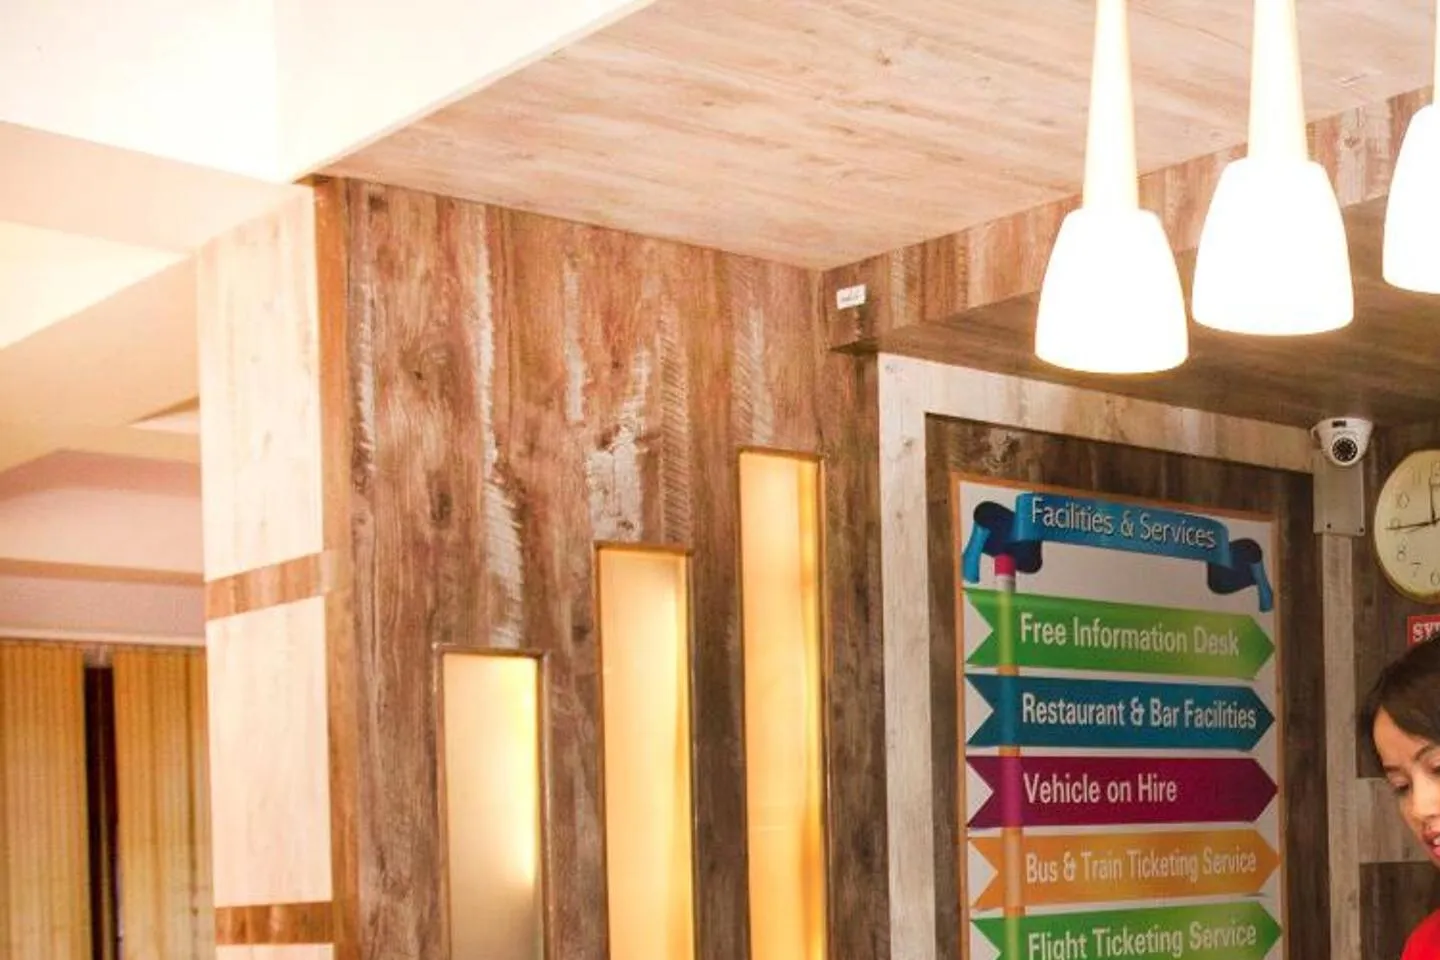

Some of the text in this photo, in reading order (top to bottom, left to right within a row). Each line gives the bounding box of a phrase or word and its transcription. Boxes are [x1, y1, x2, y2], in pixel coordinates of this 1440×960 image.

[1031, 496, 1217, 549] Facilities & Services
[1020, 612, 1240, 656] Free Information Desk
[1023, 692, 1257, 729] Restaurant & Bar Facilities
[1023, 772, 1178, 804] Vehicle on Hire
[1026, 846, 1257, 883] Bus & Train Ticketing Service
[1093, 926, 1183, 958] Ticketing
[1189, 920, 1257, 949] Service
